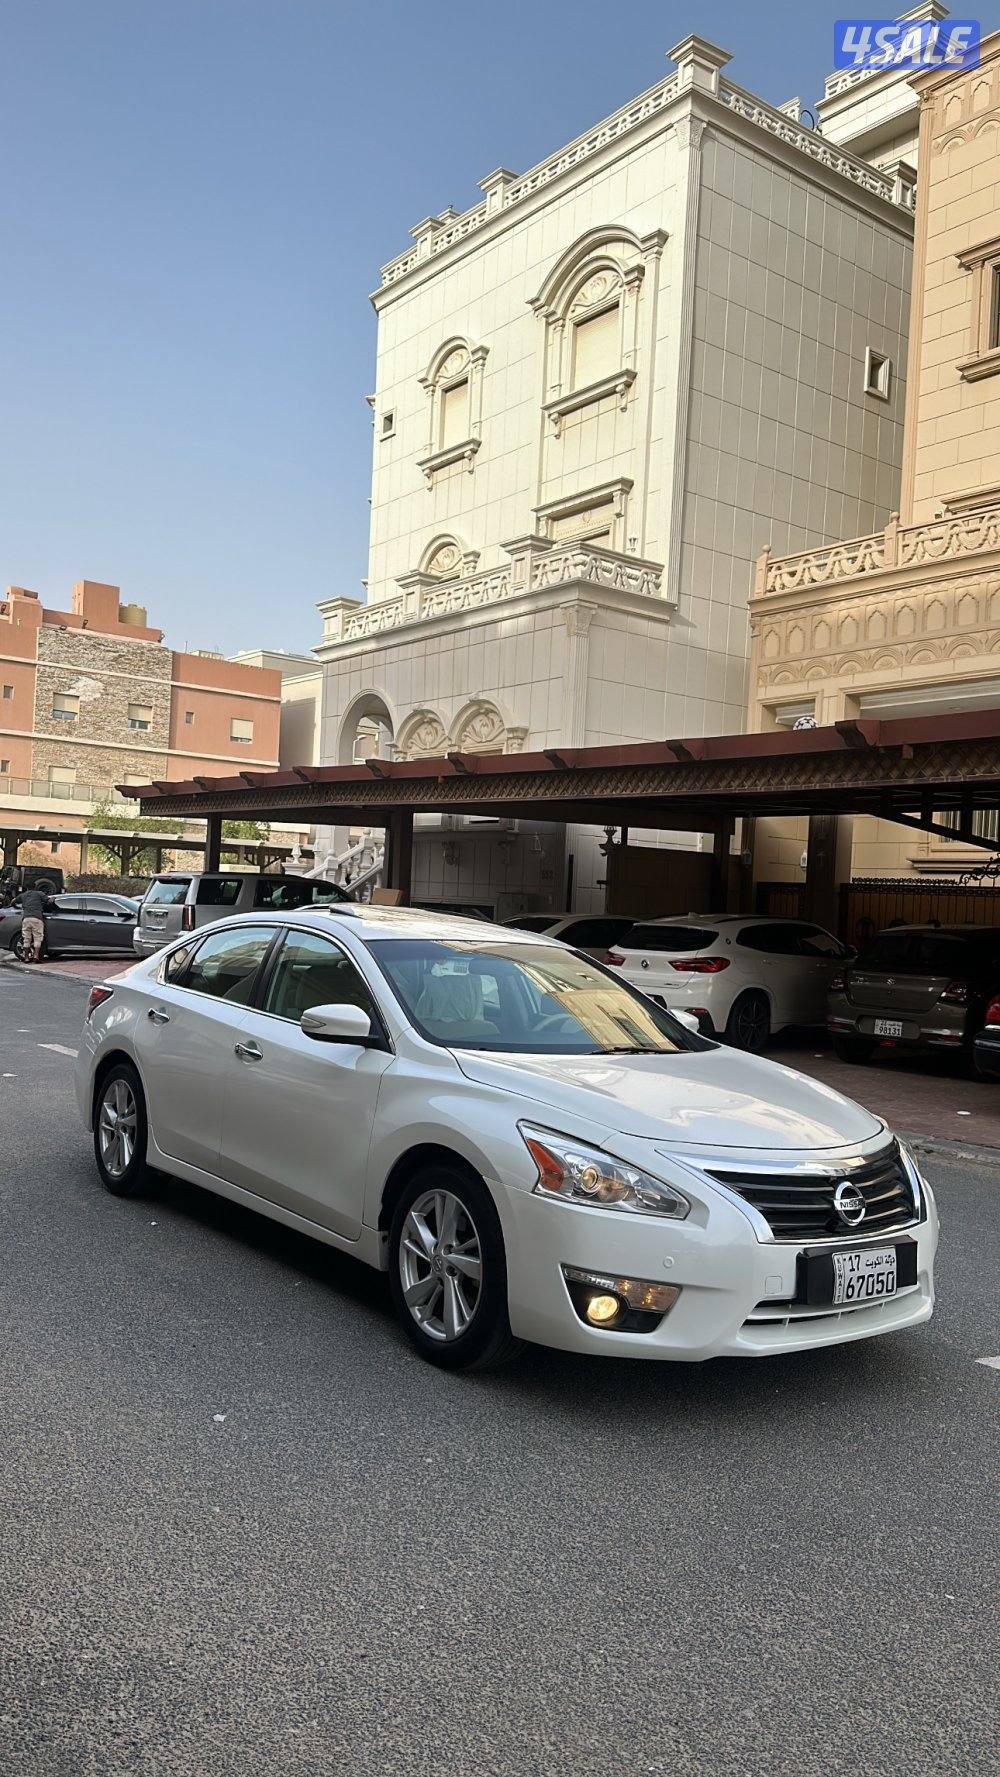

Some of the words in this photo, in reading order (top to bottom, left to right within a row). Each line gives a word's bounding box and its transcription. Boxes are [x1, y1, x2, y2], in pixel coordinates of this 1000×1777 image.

[848, 1254, 861, 1272] 17
[866, 1256, 884, 1269] الكويت
[846, 1270, 895, 1300] 67050
